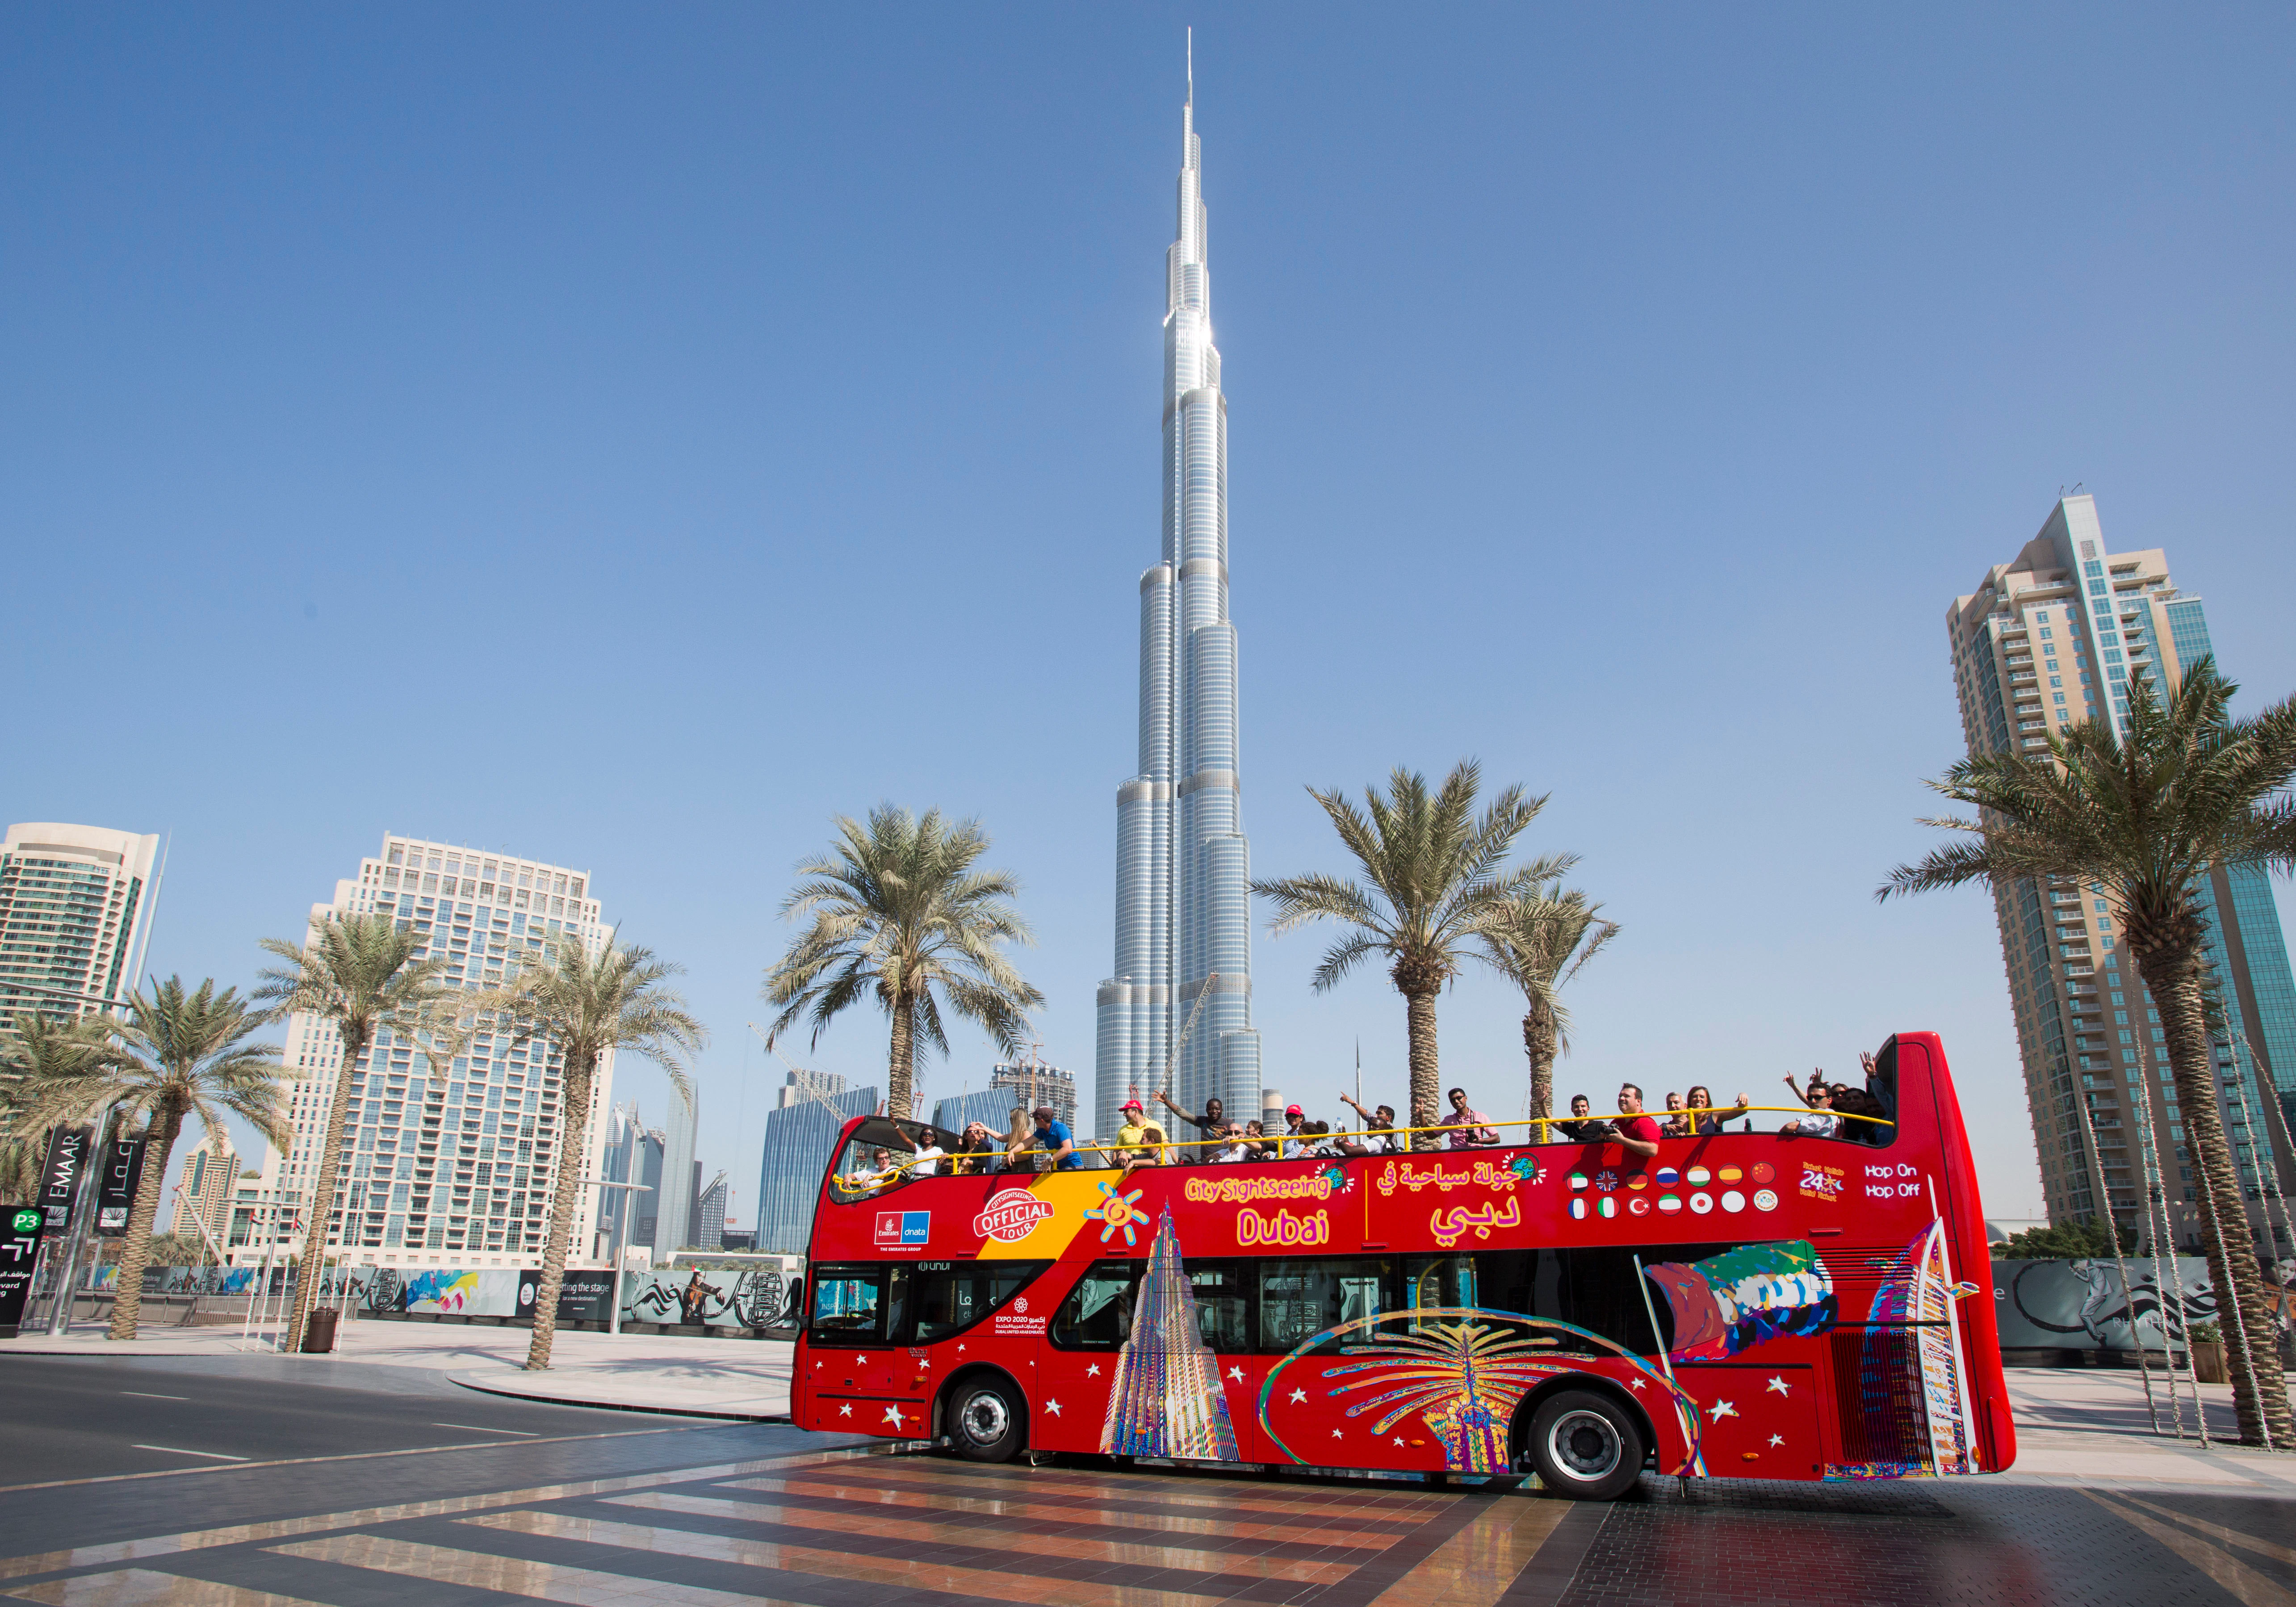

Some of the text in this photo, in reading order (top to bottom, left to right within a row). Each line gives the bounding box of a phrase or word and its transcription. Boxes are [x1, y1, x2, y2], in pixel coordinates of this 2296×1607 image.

[49, 1135, 83, 1197] EMAAR
[1803, 1162, 1822, 1172] Ticket
[1865, 1163, 1917, 1179] Hop On
[1377, 1161, 1521, 1196] جولة سياحية في
[1800, 1170, 1823, 1190] 24
[1800, 1188, 1837, 1202] Valid Ticket
[1866, 1183, 1920, 1198] Hop Off
[991, 1192, 1032, 1209] CITYSIGHTSEEING
[14, 1214, 38, 1228] P3
[982, 1204, 1049, 1231] OFFICIAL
[1430, 1196, 1521, 1247] دبي
[1002, 1223, 1032, 1238] TOUR
[1237, 1208, 1329, 1246] Dubai
[7, 1271, 31, 1279] مواقف
[561, 1282, 609, 1294] tting the stage
